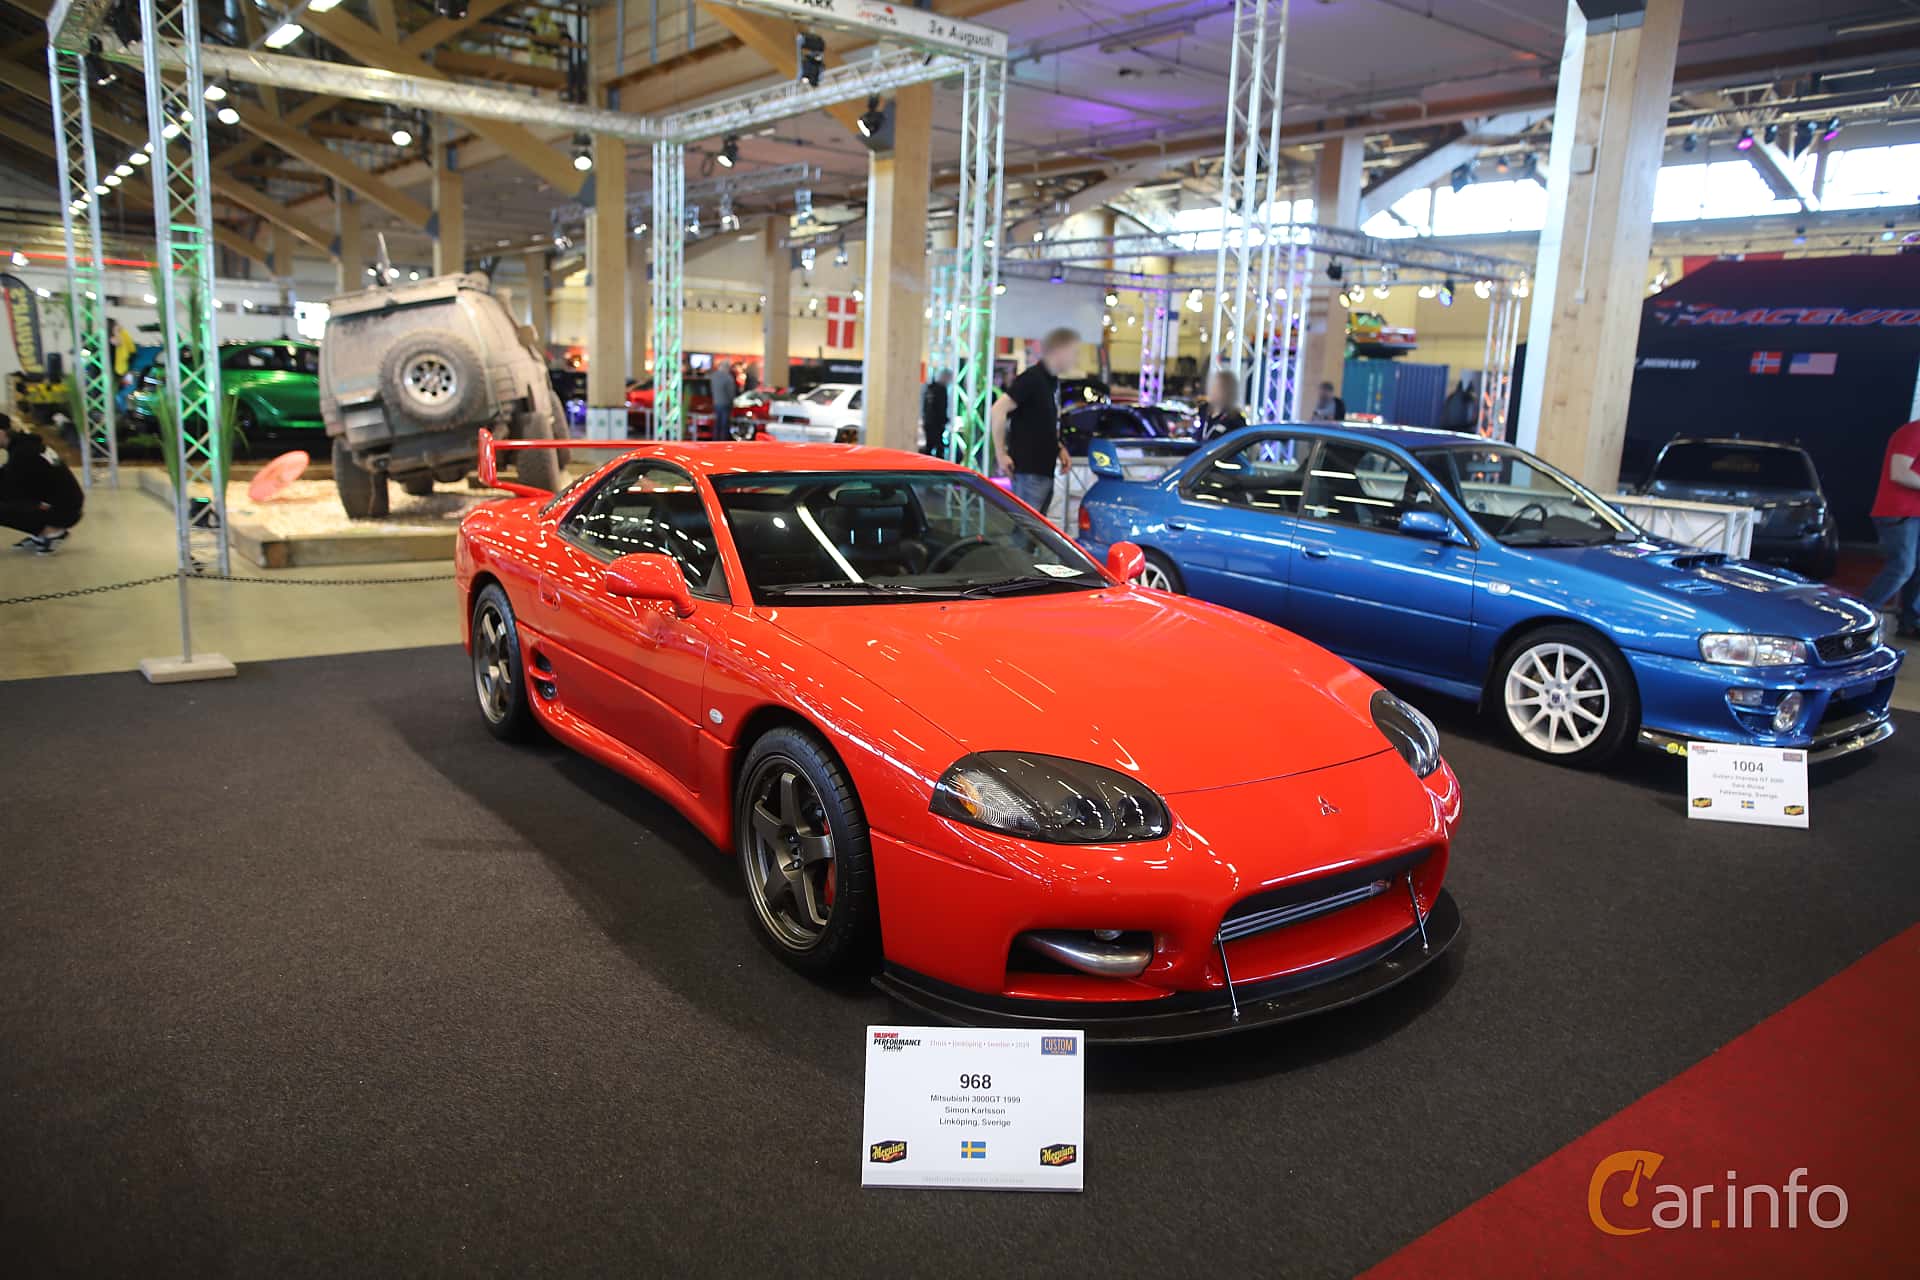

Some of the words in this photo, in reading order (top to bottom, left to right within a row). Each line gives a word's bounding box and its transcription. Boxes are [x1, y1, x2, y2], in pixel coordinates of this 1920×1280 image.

[1732, 760, 1764, 773] 1004
[873, 1038, 921, 1047] PERFORMANCE
[1044, 1038, 1073, 1051] CUSTOM
[960, 1073, 992, 1089] 968
[930, 1094, 970, 1103] Mitsubishi
[1003, 1096, 1021, 1104] 1999
[945, 1106, 970, 1114] Simon
[971, 1106, 1006, 1115] Karlsson
[981, 1118, 1011, 1128] Sverige
